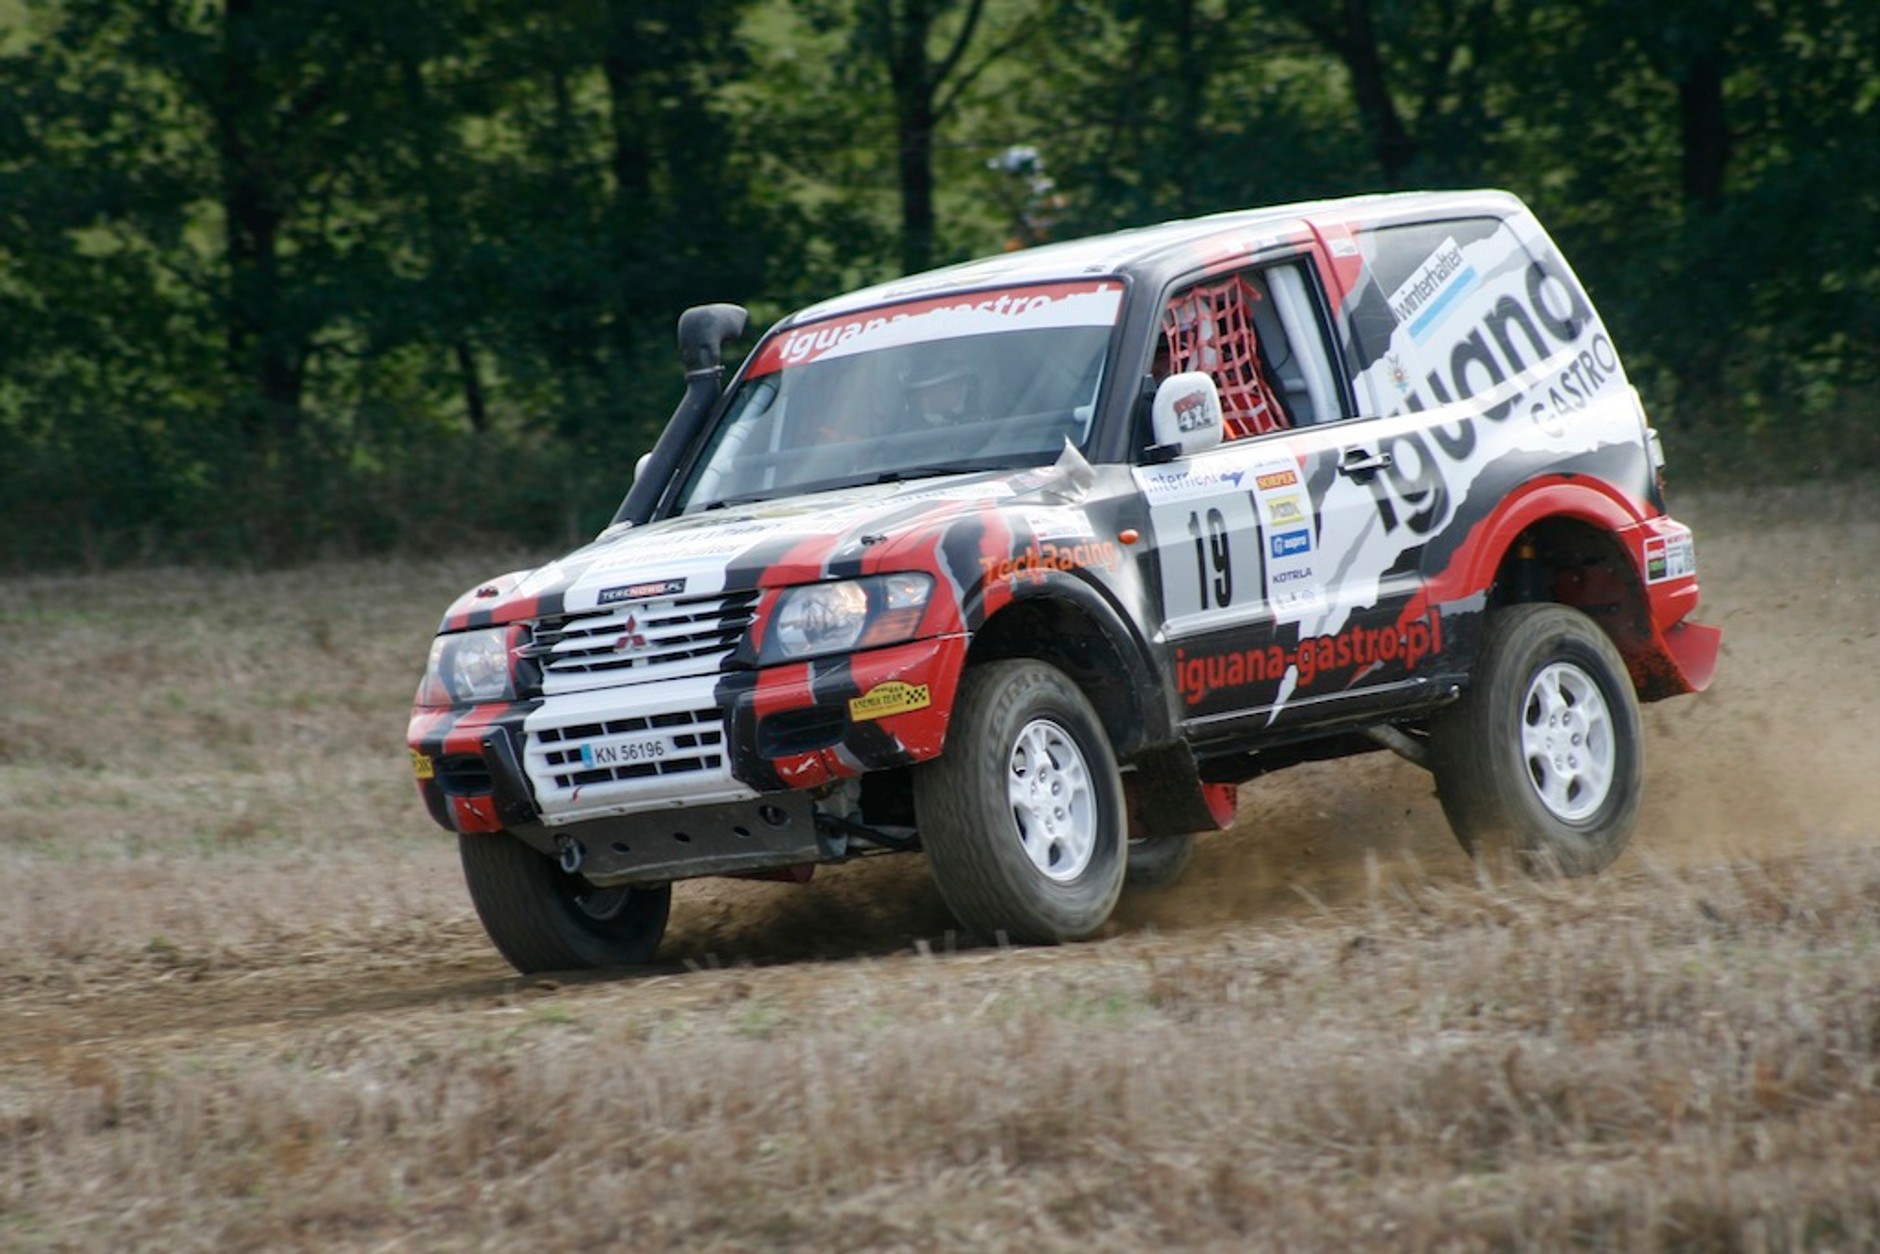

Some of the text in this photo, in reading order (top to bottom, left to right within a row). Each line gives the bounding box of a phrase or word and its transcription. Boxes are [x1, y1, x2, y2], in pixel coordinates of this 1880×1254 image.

[1395, 247, 1464, 323] winterhalter
[1530, 333, 1617, 438] GASTRO
[1188, 508, 1232, 611] 19
[1176, 607, 1442, 705] iguana-gastro.pl
[595, 741, 664, 763] KN 56196
